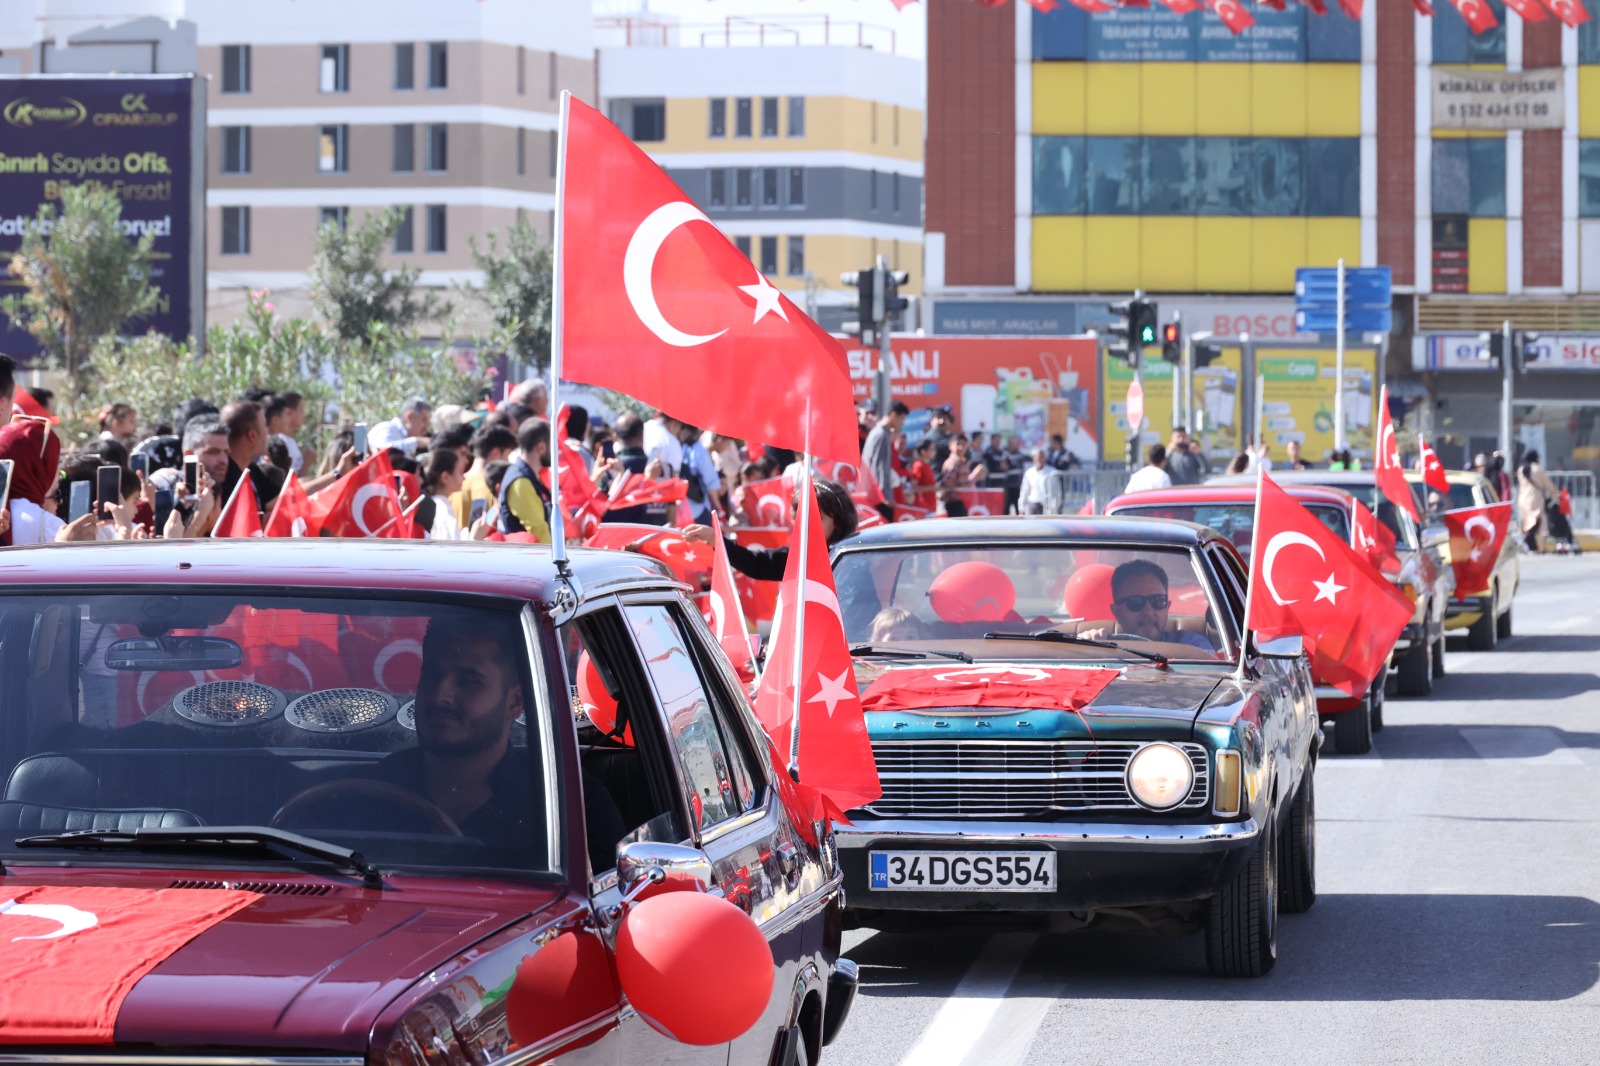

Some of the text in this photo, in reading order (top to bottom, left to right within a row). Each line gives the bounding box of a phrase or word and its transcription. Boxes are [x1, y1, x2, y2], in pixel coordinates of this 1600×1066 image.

[52, 152, 120, 178] Sayıda
[893, 719, 1031, 728] FORD
[874, 872, 887, 881] TR
